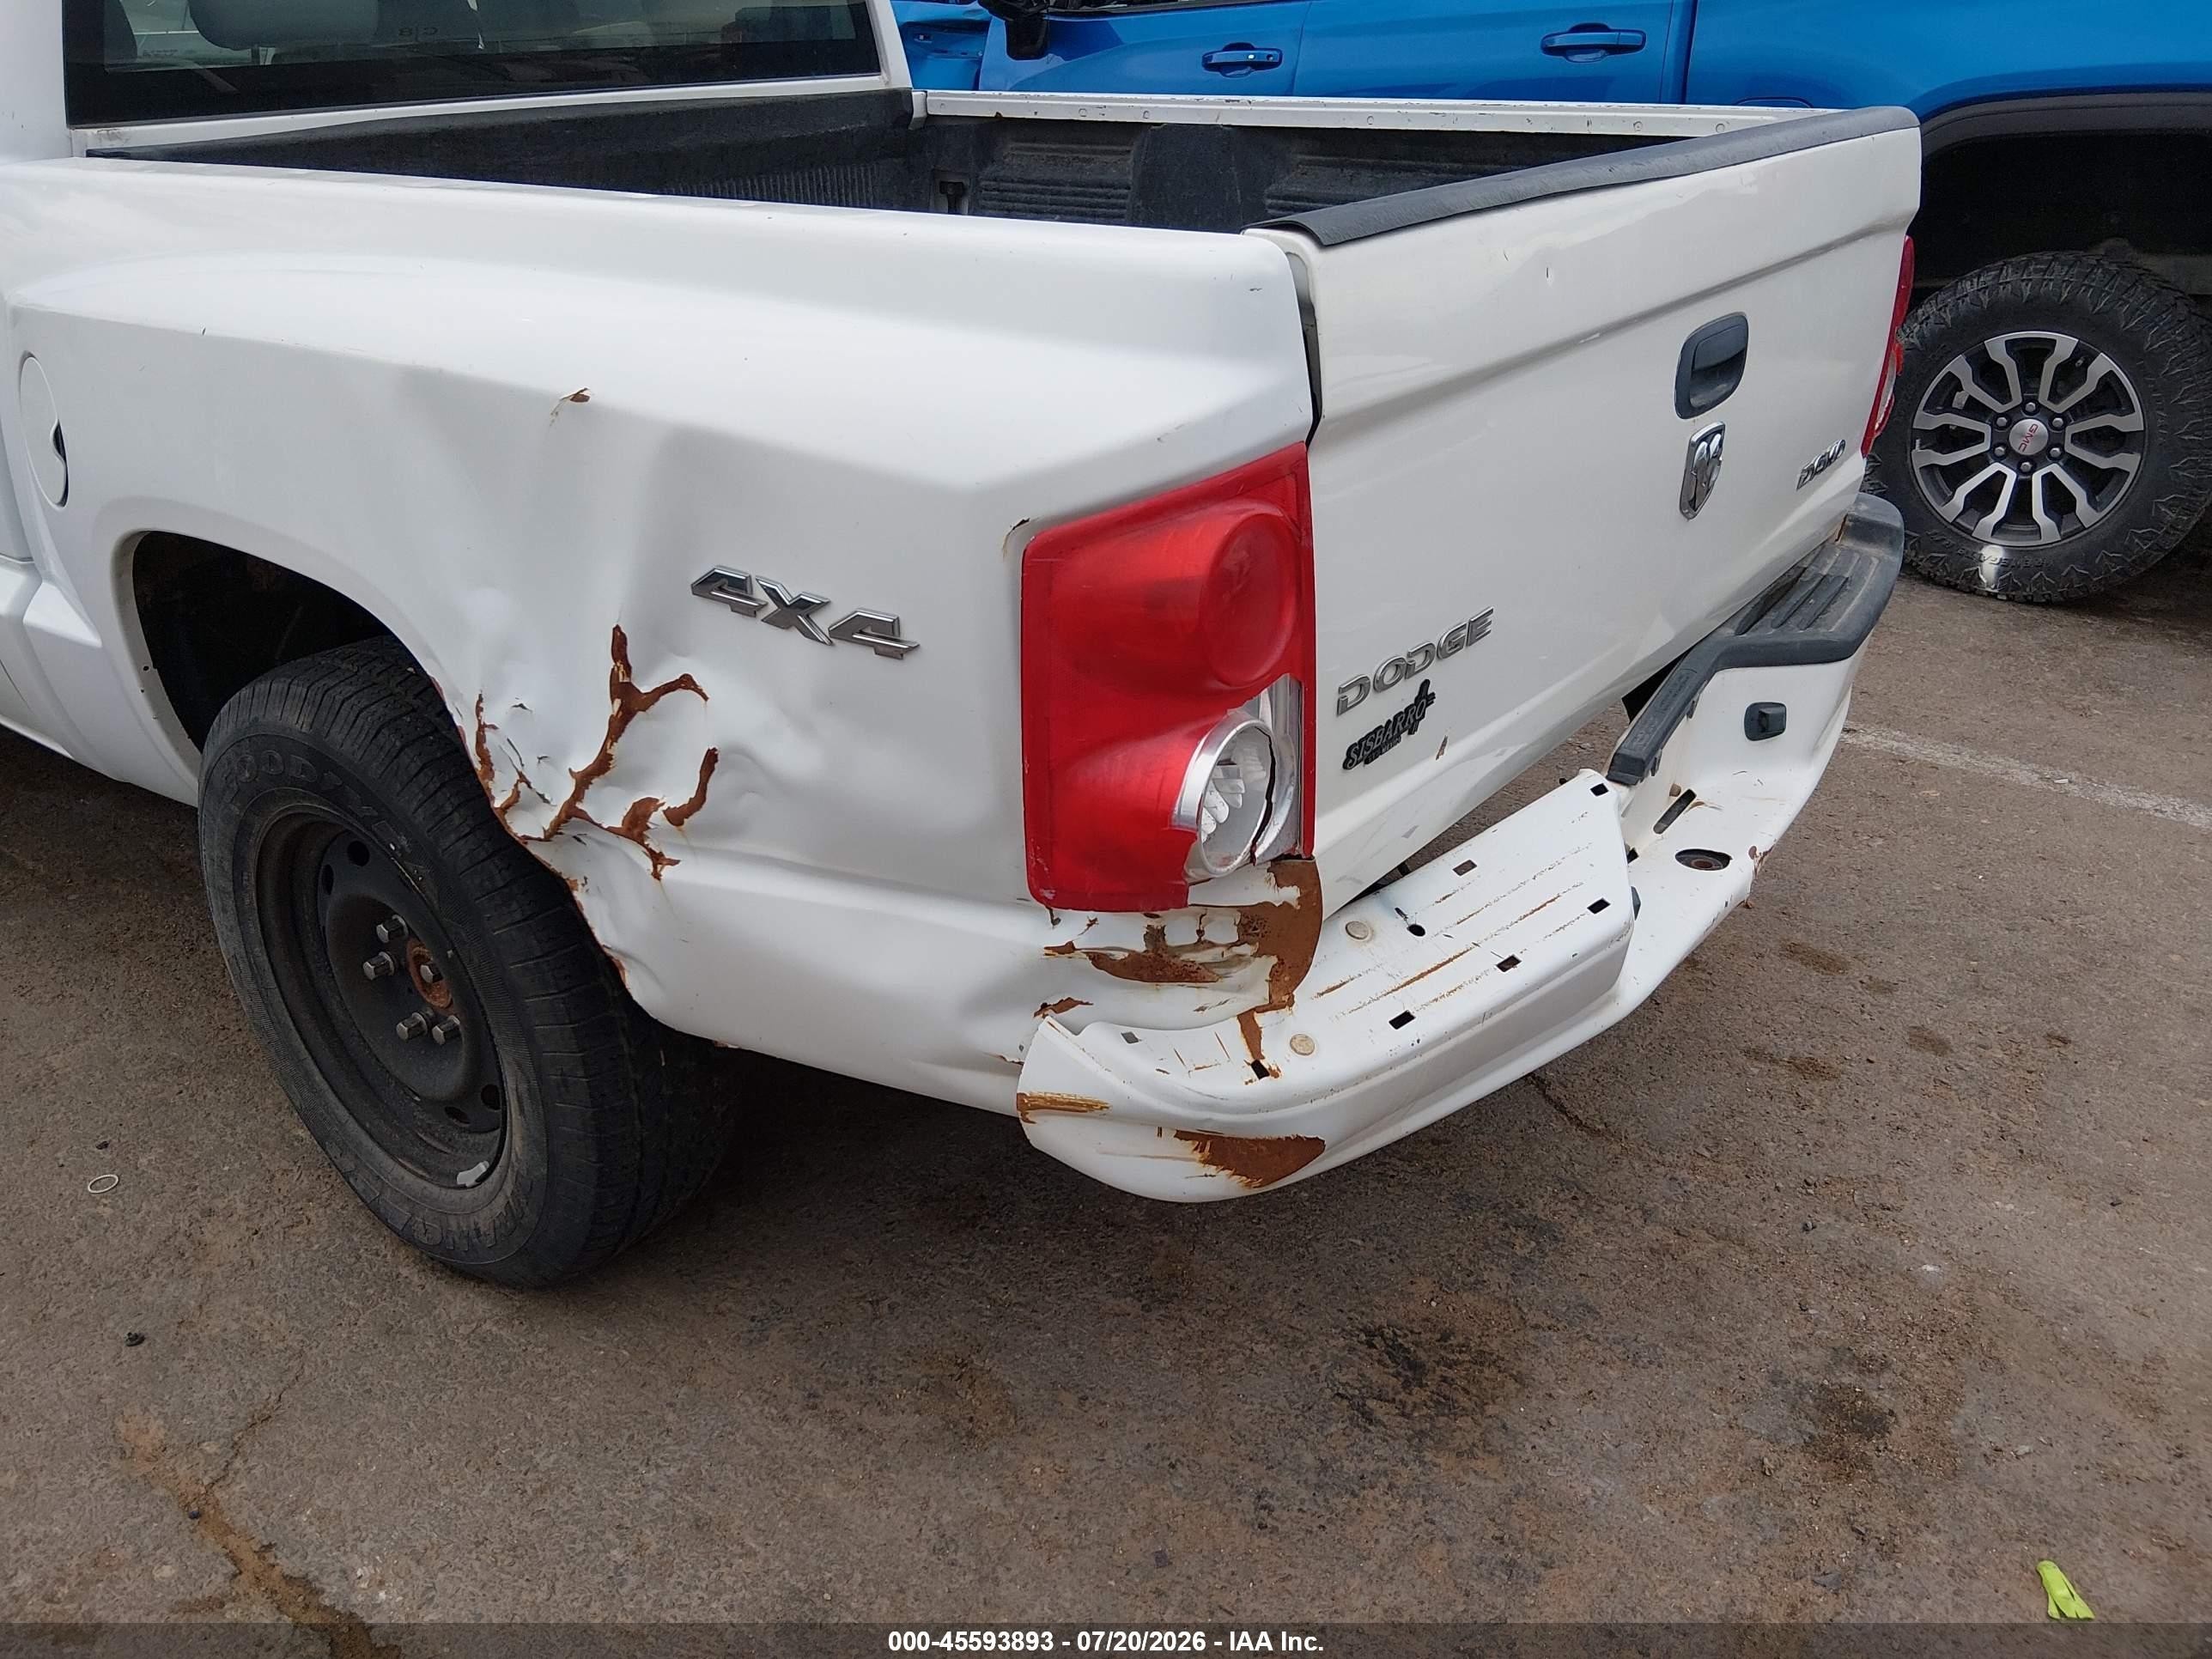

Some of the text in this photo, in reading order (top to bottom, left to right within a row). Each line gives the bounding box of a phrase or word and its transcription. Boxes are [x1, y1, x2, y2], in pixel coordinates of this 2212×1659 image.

[2018, 423, 2039, 453] GMC
[690, 564, 921, 659] 4X4
[1337, 605, 1494, 716] DODGE
[1343, 699, 1427, 770] SISBARRO
